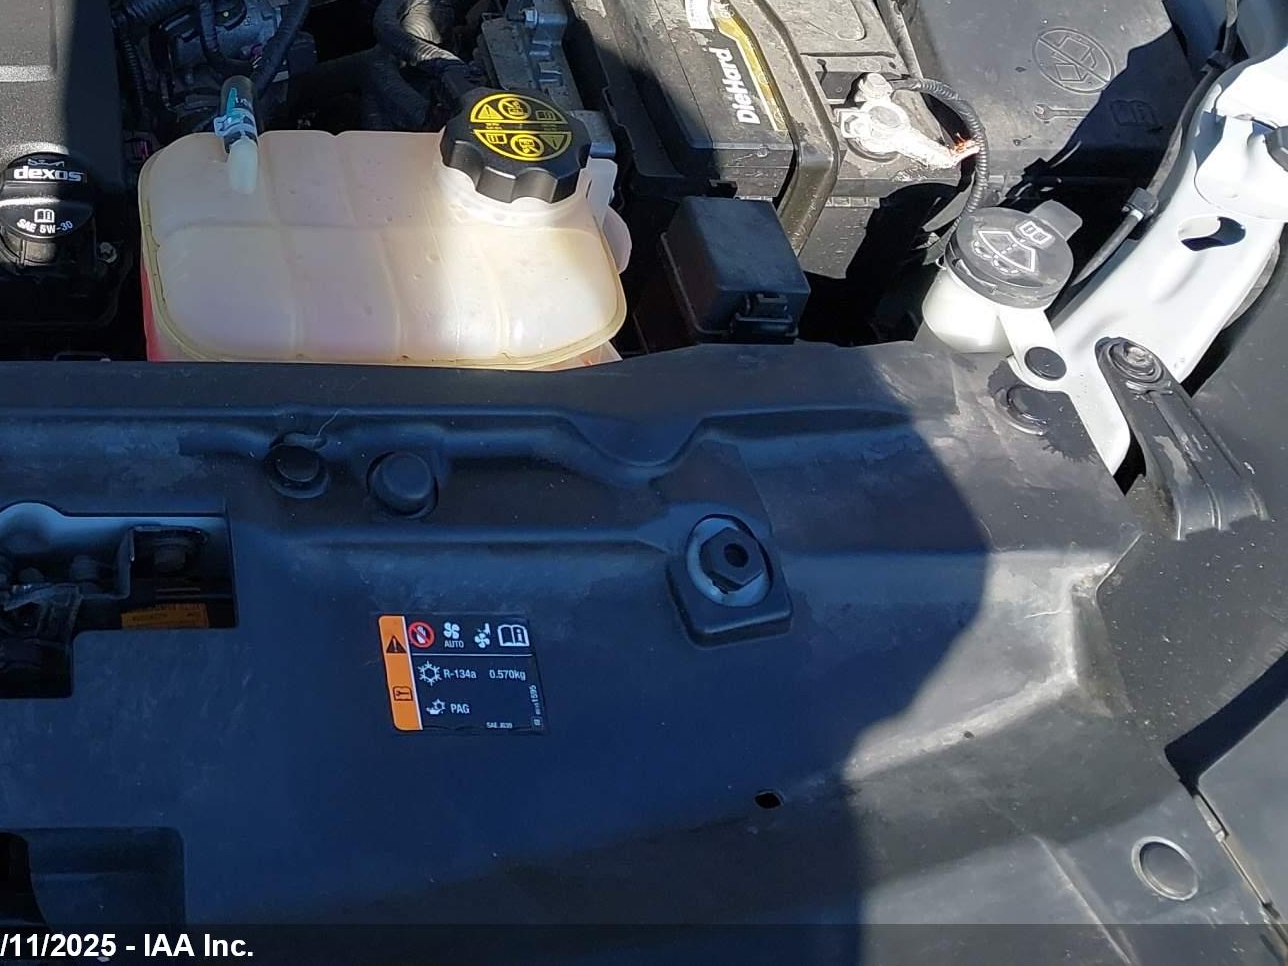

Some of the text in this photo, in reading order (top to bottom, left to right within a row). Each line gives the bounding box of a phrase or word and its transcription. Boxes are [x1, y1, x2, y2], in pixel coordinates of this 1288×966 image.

[709, 46, 761, 125] DieHard
[13, 166, 84, 182] dexos
[16, 218, 74, 234] SAE 5W-30
[444, 640, 465, 649] AUTO
[443, 669, 526, 681] R-134a 0.570kg
[450, 703, 470, 714] PAG
